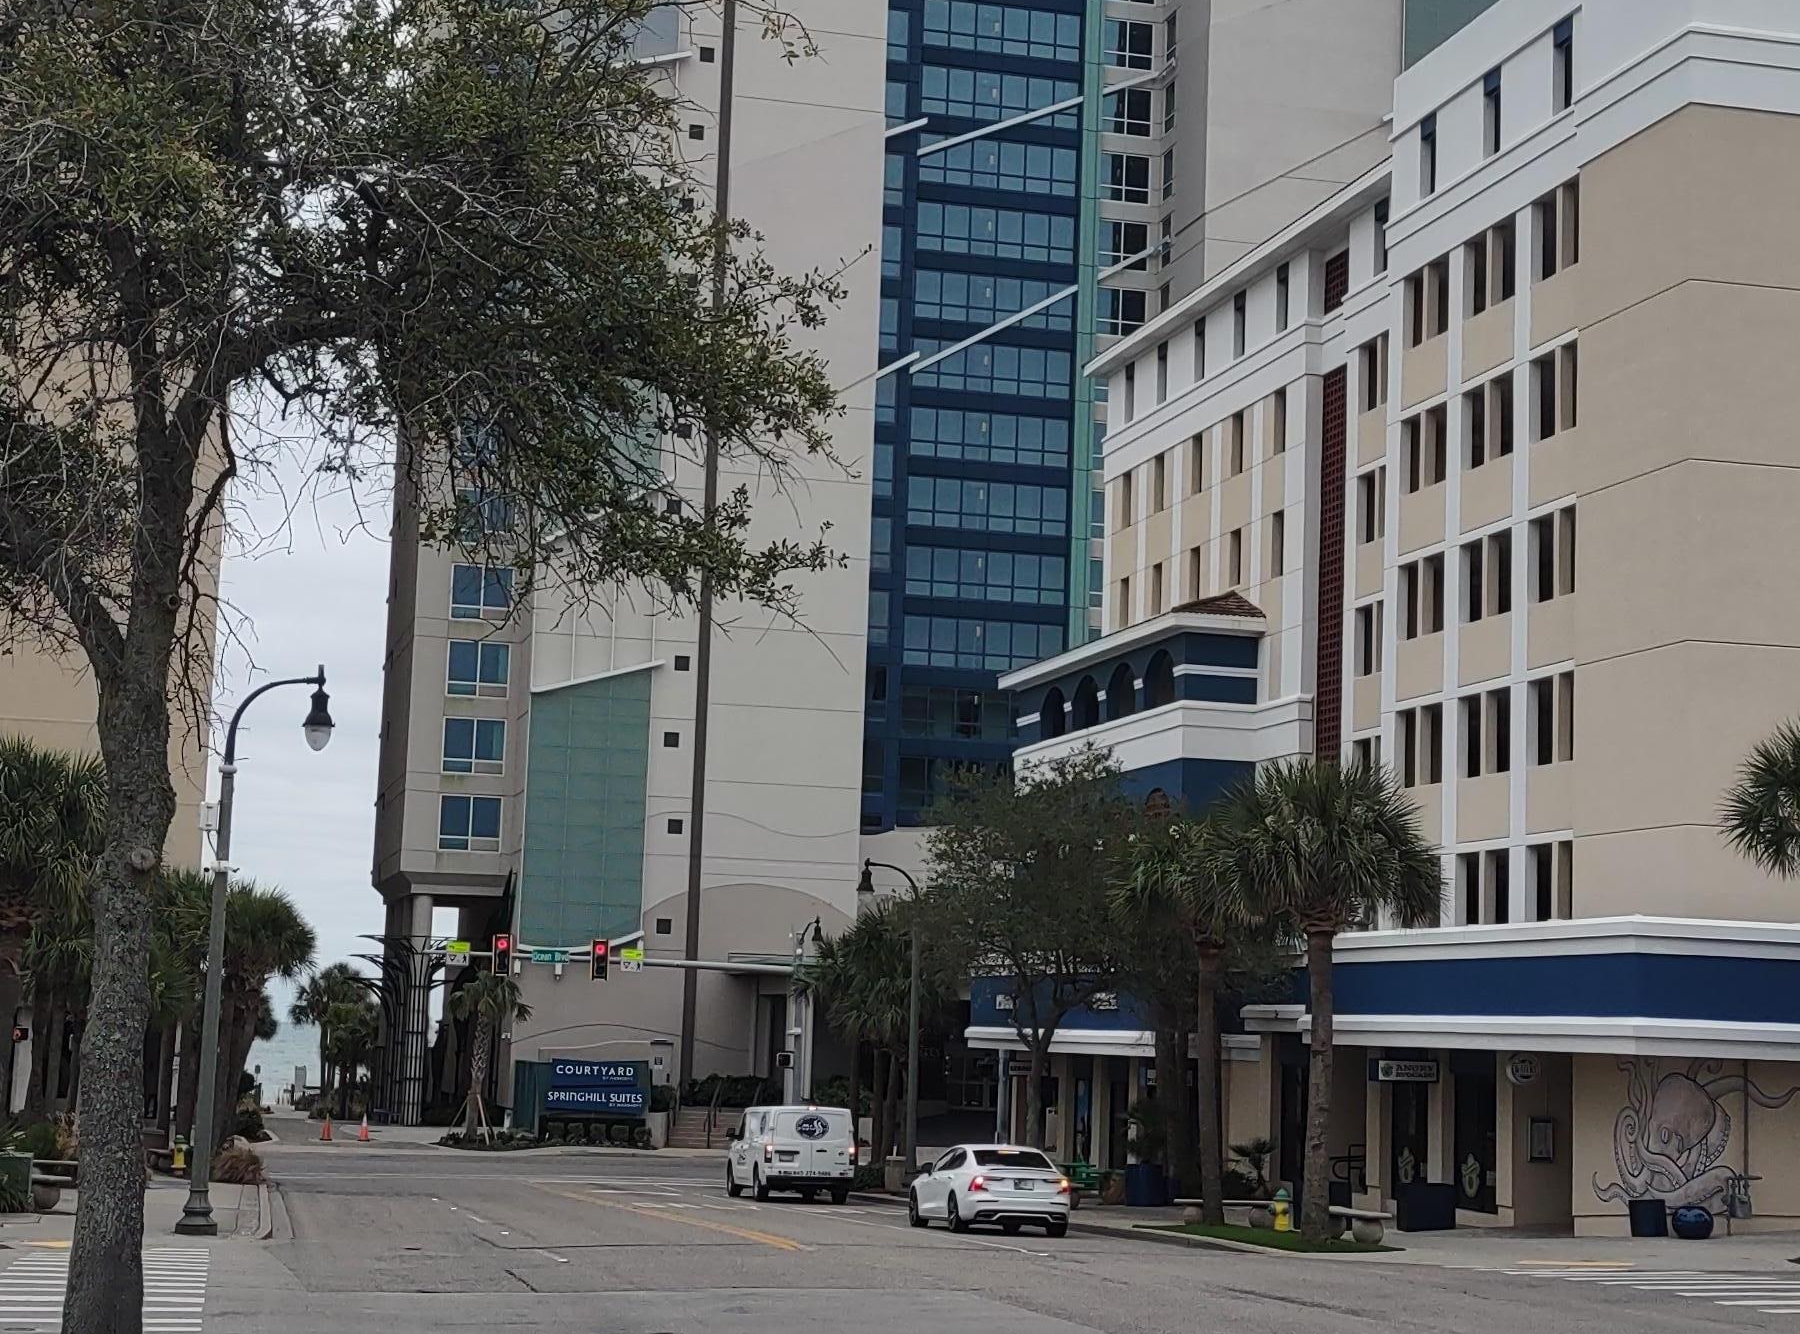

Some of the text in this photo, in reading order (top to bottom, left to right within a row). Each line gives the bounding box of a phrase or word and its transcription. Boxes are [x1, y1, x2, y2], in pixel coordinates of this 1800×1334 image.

[533, 952, 552, 961] Ocean
[556, 1065, 634, 1077] COURTYARD
[547, 1091, 643, 1103] SPRINGHILL SUITES
